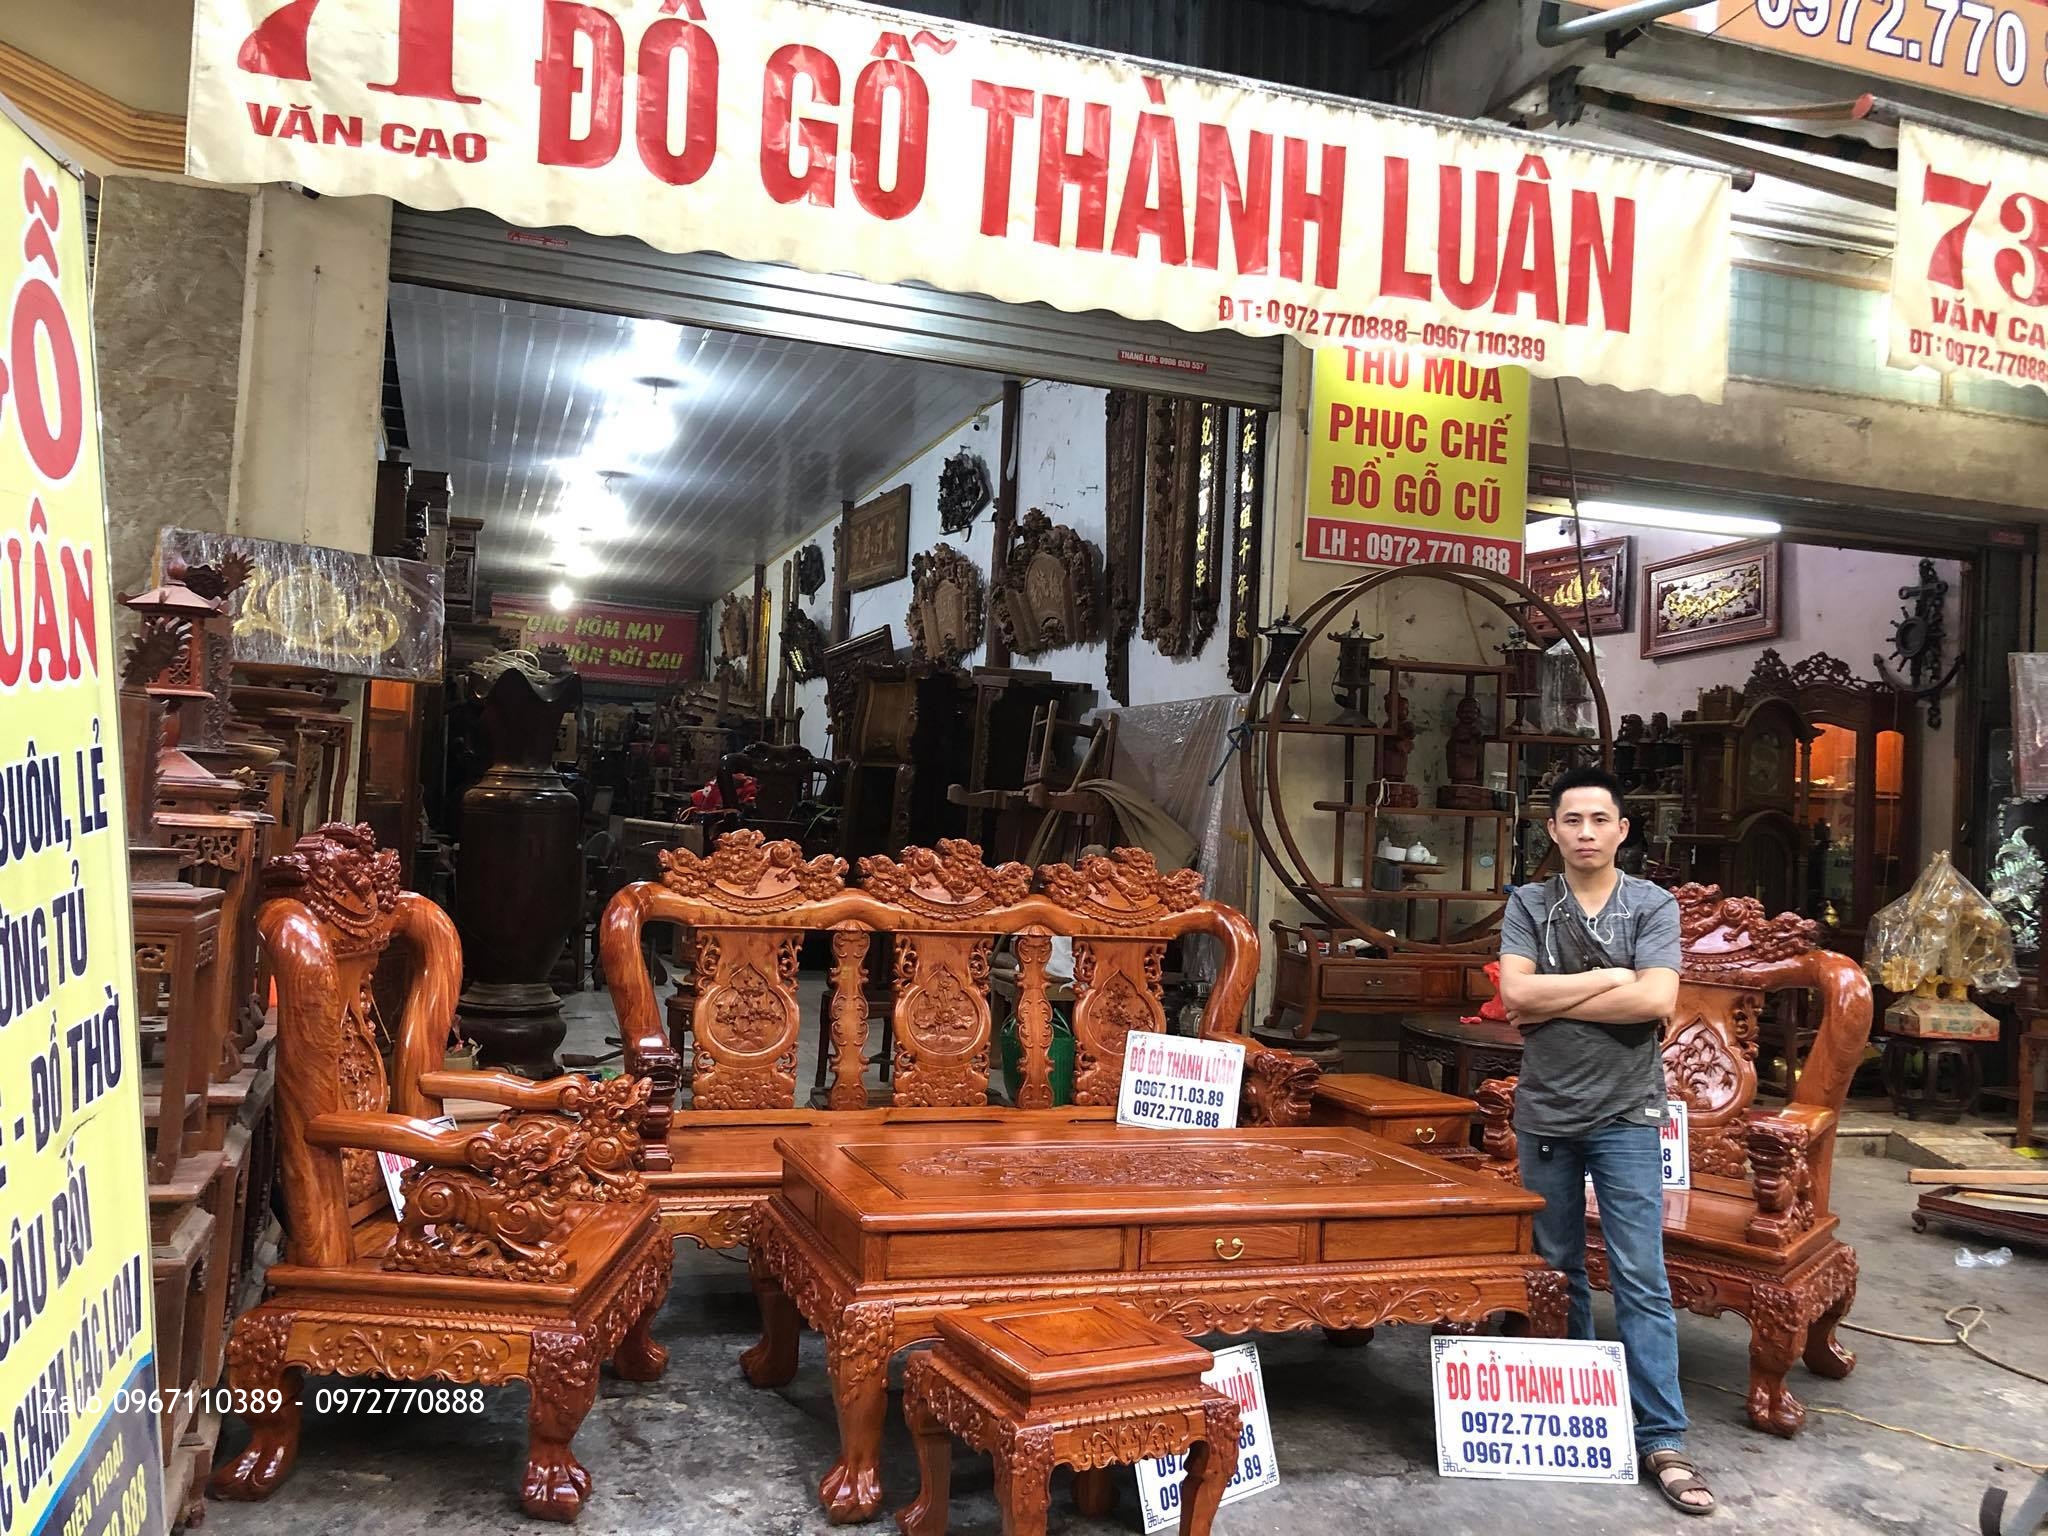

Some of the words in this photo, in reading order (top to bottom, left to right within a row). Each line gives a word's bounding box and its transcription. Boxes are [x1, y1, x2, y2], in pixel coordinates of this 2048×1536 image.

[246, 101, 362, 147] VĂN
[380, 123, 487, 163] CAO
[760, 30, 957, 220] GỖ
[972, 77, 1347, 289] THÀNH
[1379, 155, 1635, 333] LUÂN
[1921, 163, 2048, 307] 73
[0, 167, 82, 481] Ỗ
[1931, 297, 1998, 338] VĂN
[2008, 317, 2048, 350] CA
[1343, 345, 1409, 389] THU
[1423, 356, 1503, 403] MUA
[1945, 338, 2048, 383] 0972.77088
[1329, 402, 1427, 459] PHỤC
[1440, 413, 1512, 465] CHẾ
[1331, 456, 1381, 509] ĐỒ
[1394, 462, 1441, 517] GỖ
[1454, 477, 1500, 524] CŨ
[625, 622, 665, 643] NAY
[646, 651, 683, 669] SAU
[76, 717, 108, 835] LẺ
[52, 860, 88, 985] TỦ
[31, 1009, 62, 1154] ĐỒ
[66, 985, 122, 1113] THỜ
[1134, 1079, 1224, 1107] 0967.11.03.89
[1133, 1100, 1219, 1128] 0972.770.888
[52, 1139, 92, 1288] ĐỐI
[14, 1348, 70, 1504] CHẠM
[69, 1297, 104, 1420] CÁC
[103, 1254, 141, 1371] LOẠI
[1477, 1350, 1501, 1402] GỖ
[1505, 1359, 1565, 1404] THÀNH
[1569, 1361, 1617, 1406] LUÂN
[1461, 1411, 1608, 1439] 0972.770.888
[1463, 1441, 1612, 1469] 0967.11.03.89
[92, 1432, 124, 1506] THOẠI
